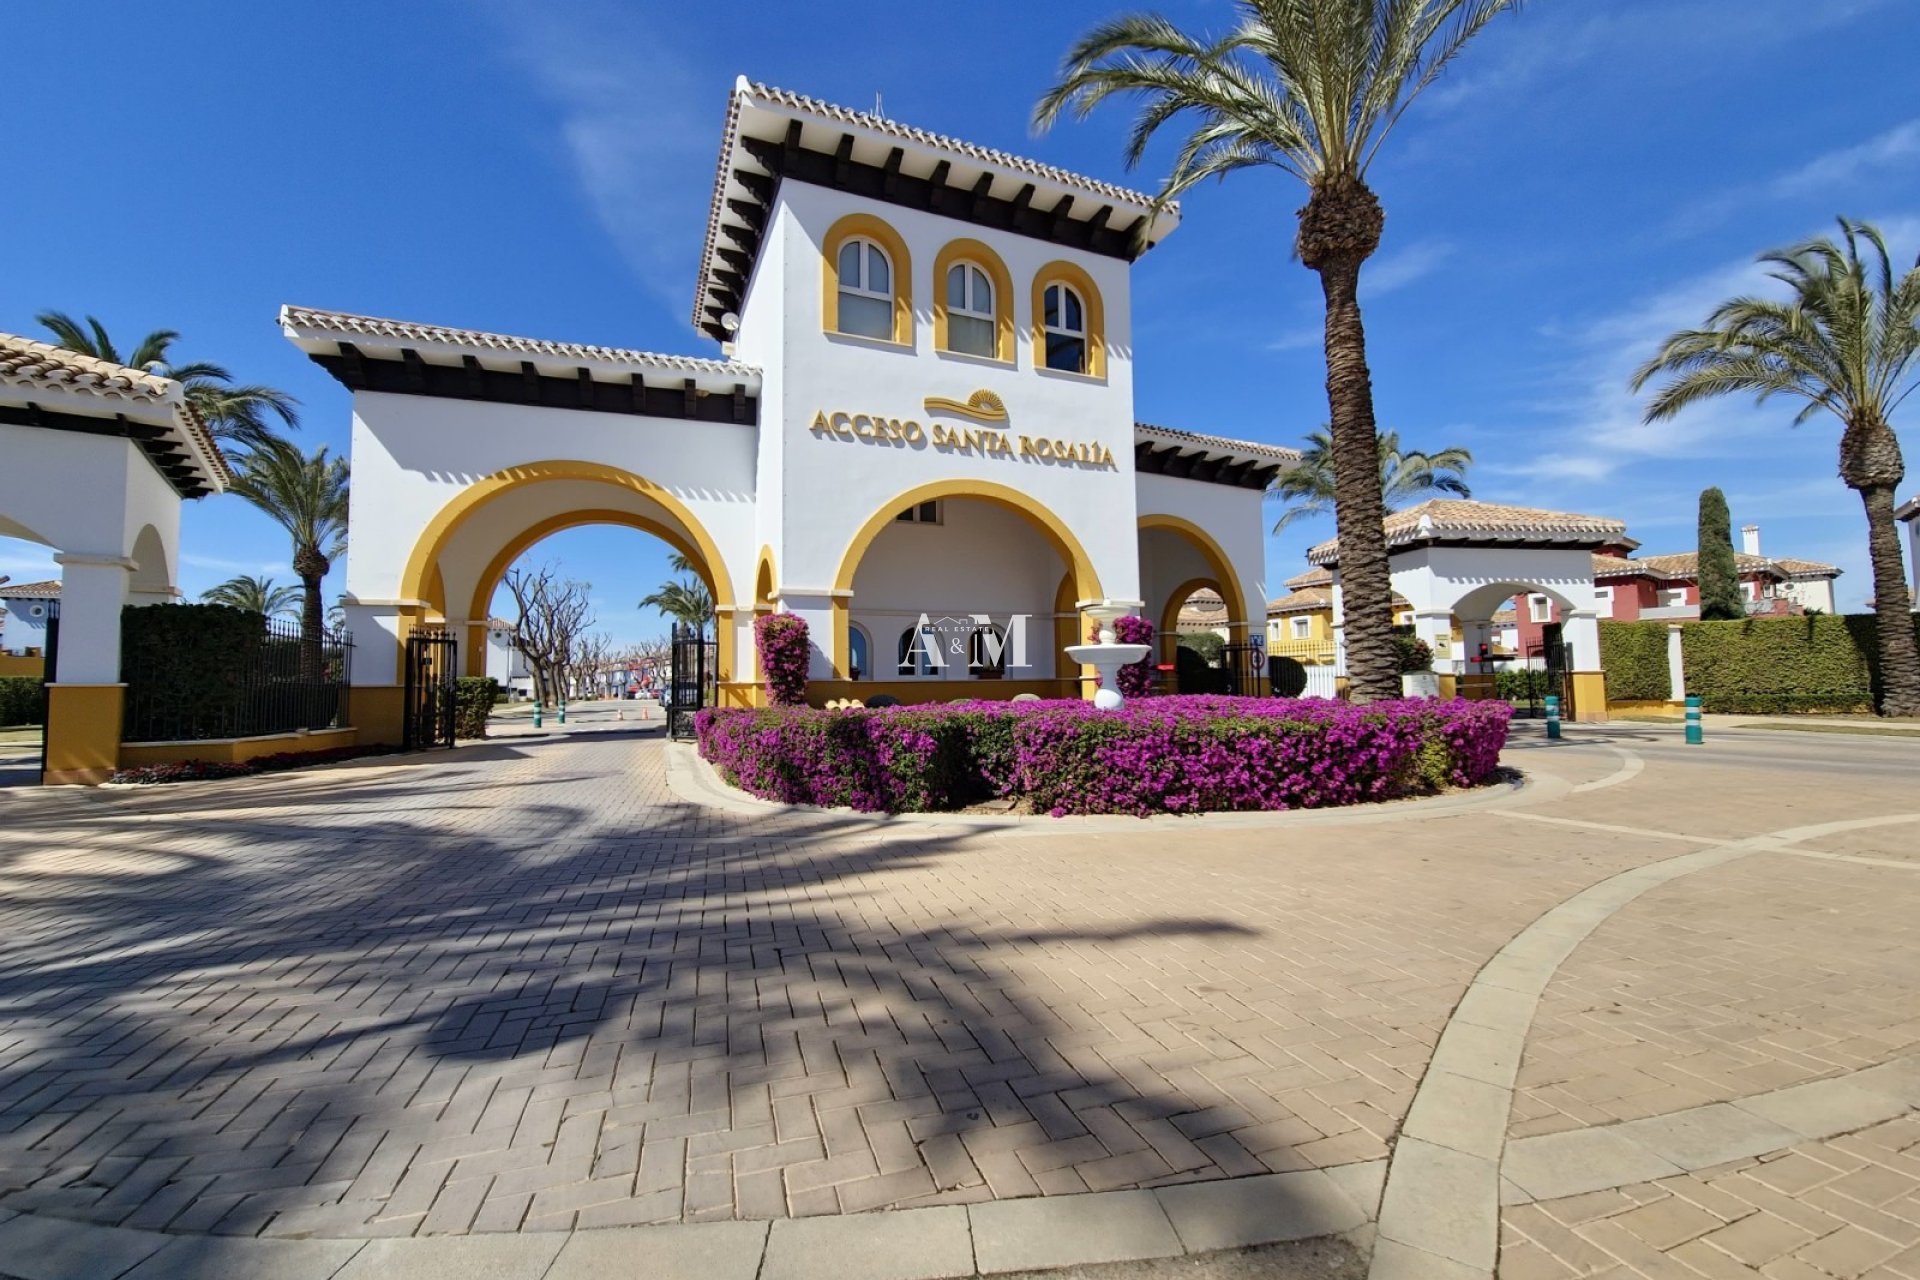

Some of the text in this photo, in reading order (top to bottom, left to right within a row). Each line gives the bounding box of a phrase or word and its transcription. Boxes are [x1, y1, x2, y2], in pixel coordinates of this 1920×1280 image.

[811, 410, 1116, 467] ACCESO SANTA ROSALÍA
